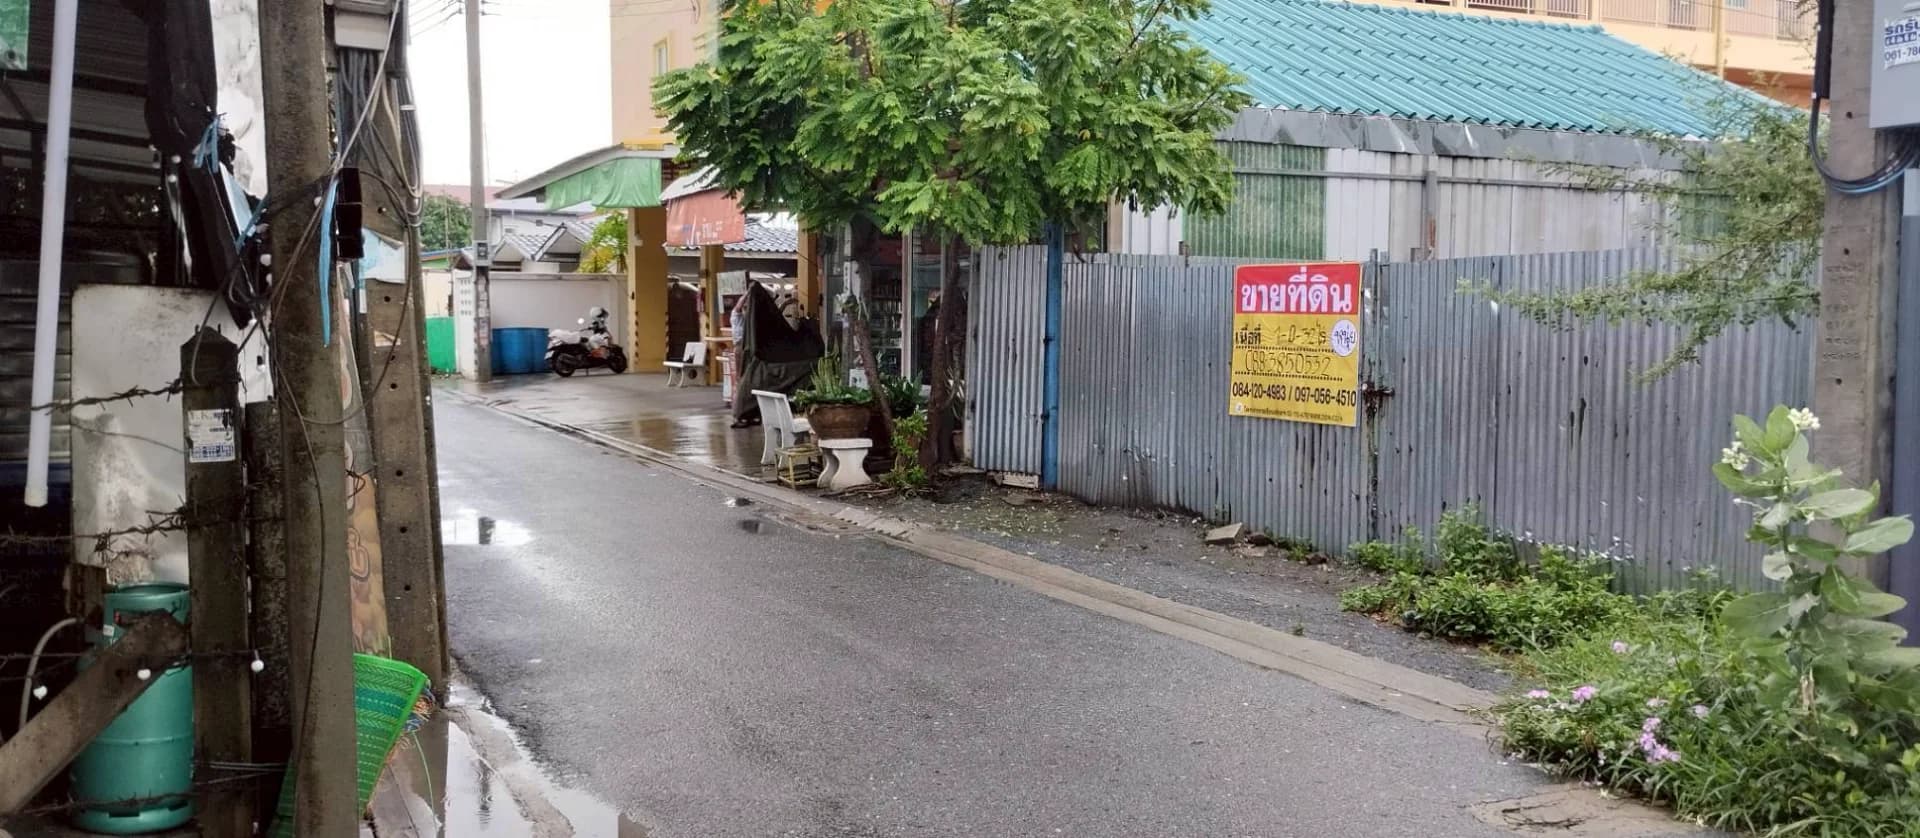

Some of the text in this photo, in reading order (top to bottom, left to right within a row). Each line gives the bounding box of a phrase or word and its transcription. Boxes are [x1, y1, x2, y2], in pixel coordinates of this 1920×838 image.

[1884, 46, 1920, 61] 061-78
[1241, 266, 1352, 313] ขายที่ดิน
[1232, 382, 1286, 401] 084-120-4983
[1295, 386, 1357, 407] 097-056-4510
